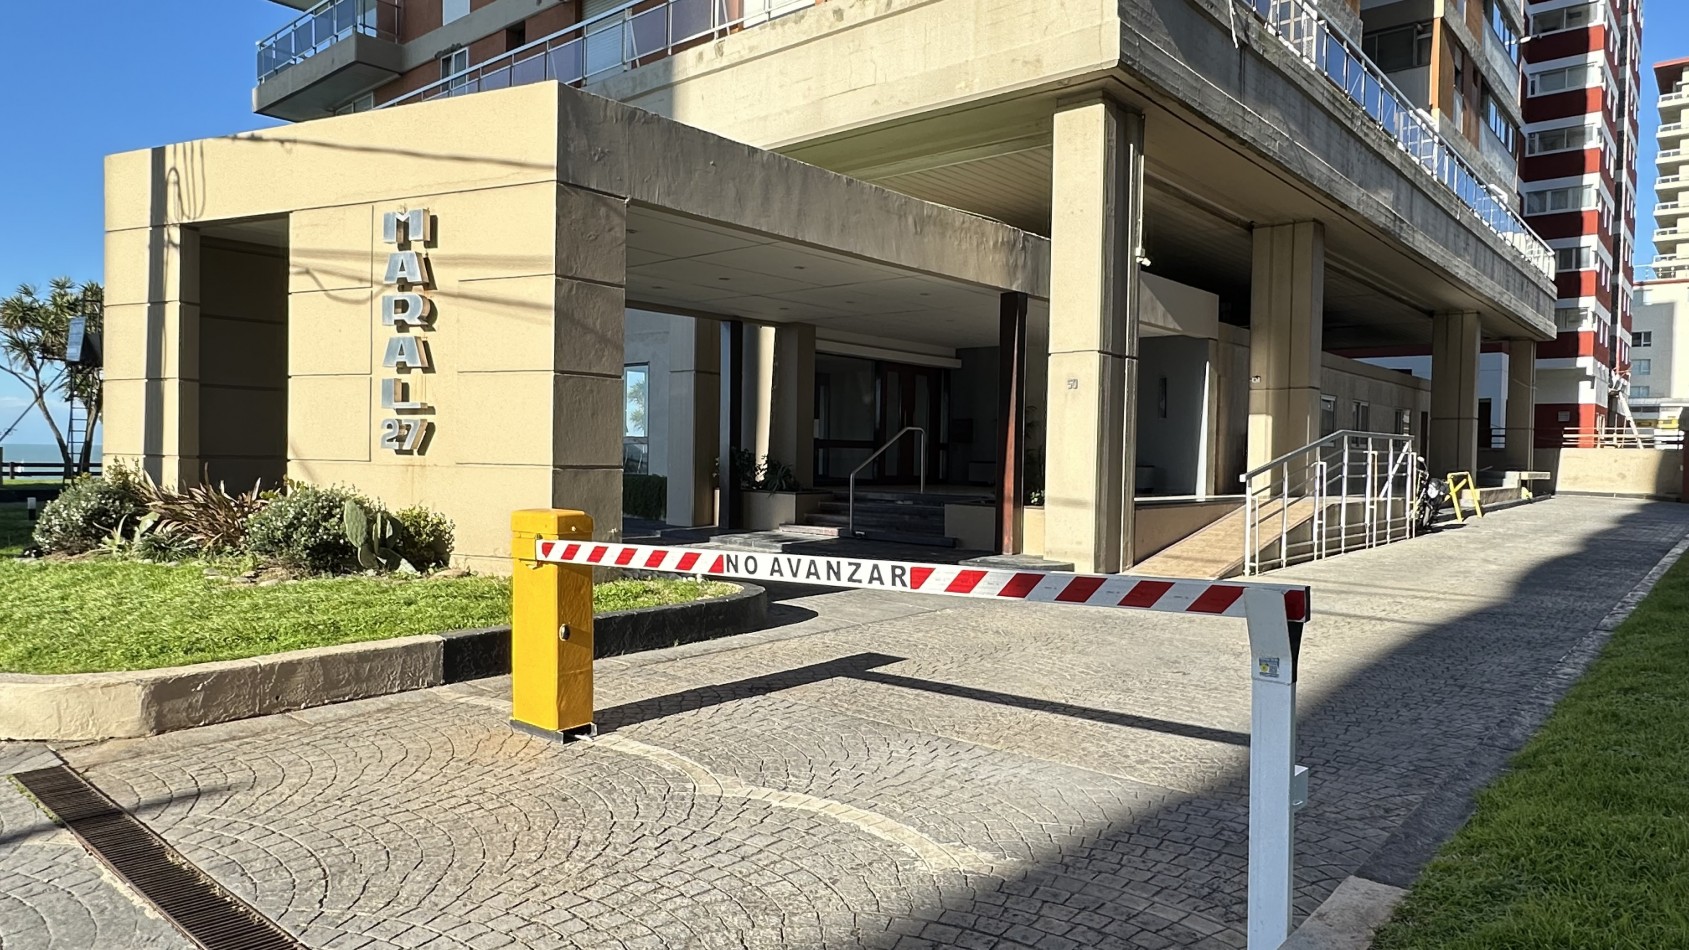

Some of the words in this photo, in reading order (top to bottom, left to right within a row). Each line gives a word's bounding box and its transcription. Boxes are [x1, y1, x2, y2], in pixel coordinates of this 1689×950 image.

[382, 208, 431, 409] MARAL
[380, 418, 428, 451] 27
[725, 553, 759, 575] NO
[769, 556, 909, 588] AVANZAR
